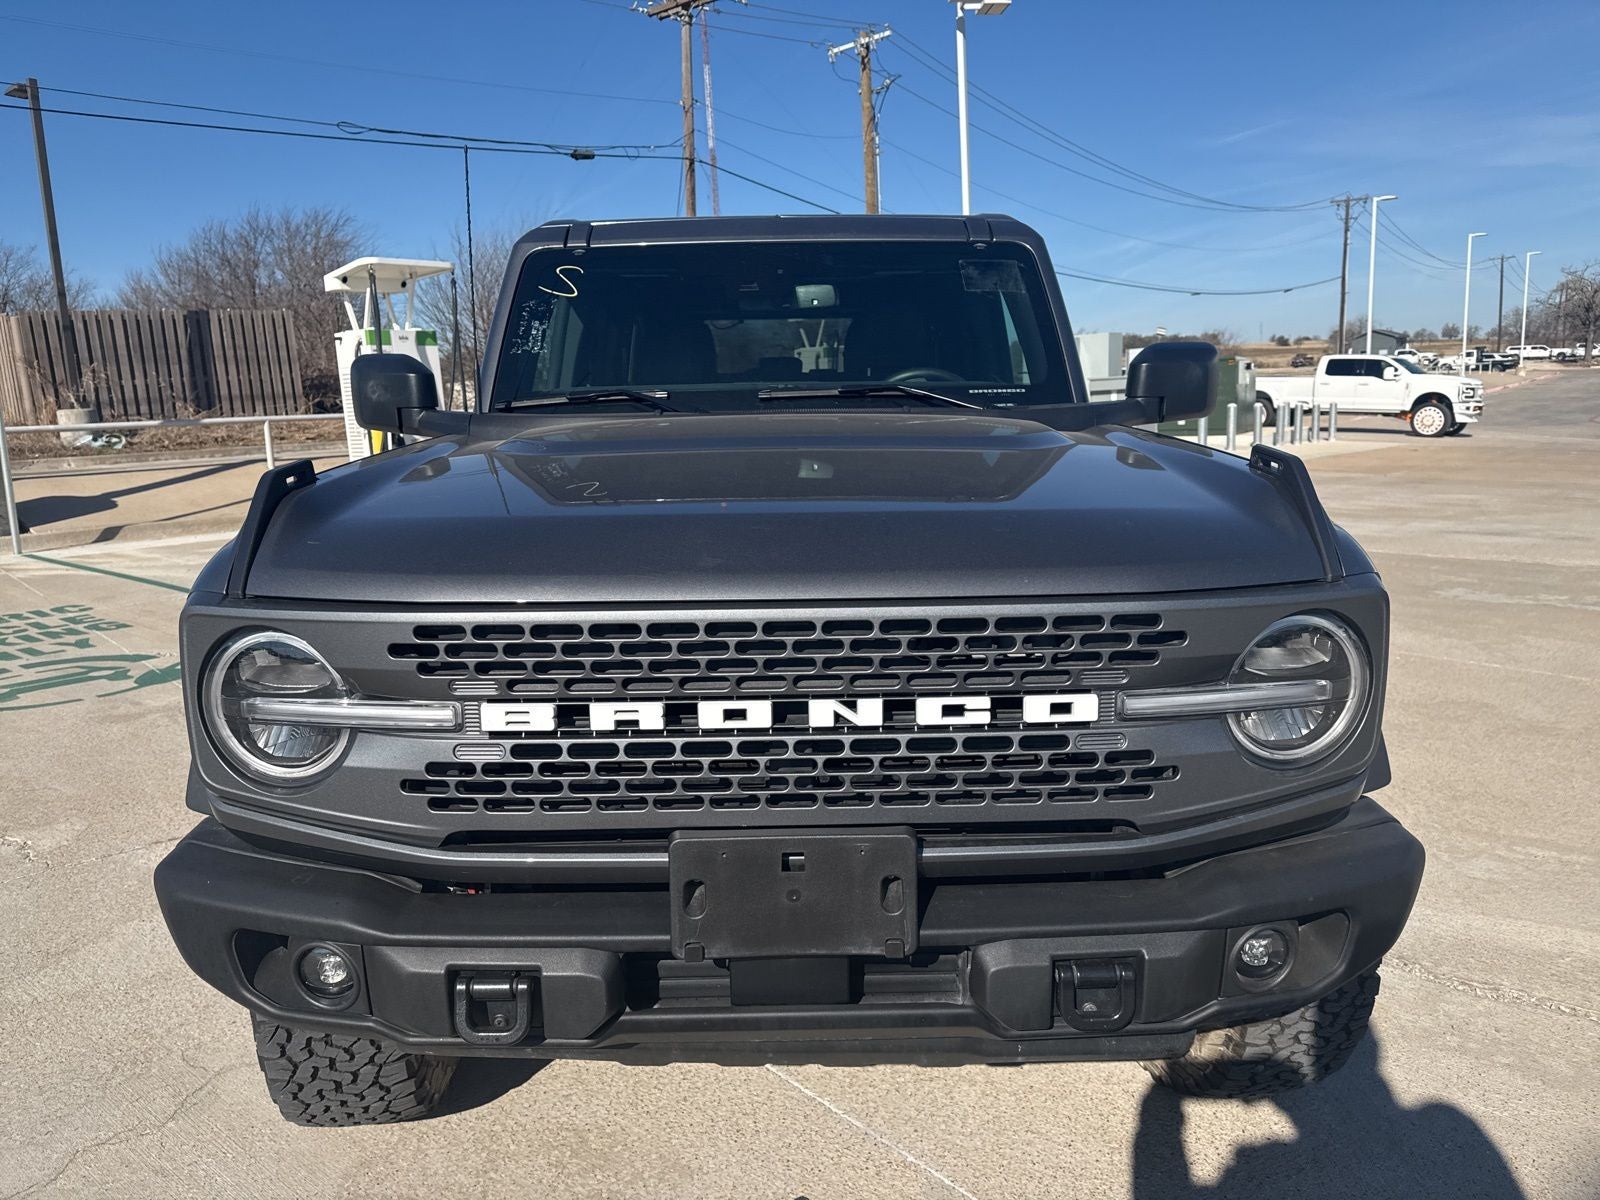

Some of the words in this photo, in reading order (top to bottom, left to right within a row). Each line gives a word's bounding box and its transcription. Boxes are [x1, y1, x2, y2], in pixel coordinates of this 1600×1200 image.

[538, 265, 584, 297] S
[0, 604, 94, 624] RIC
[480, 693, 1099, 732] BRONCO
